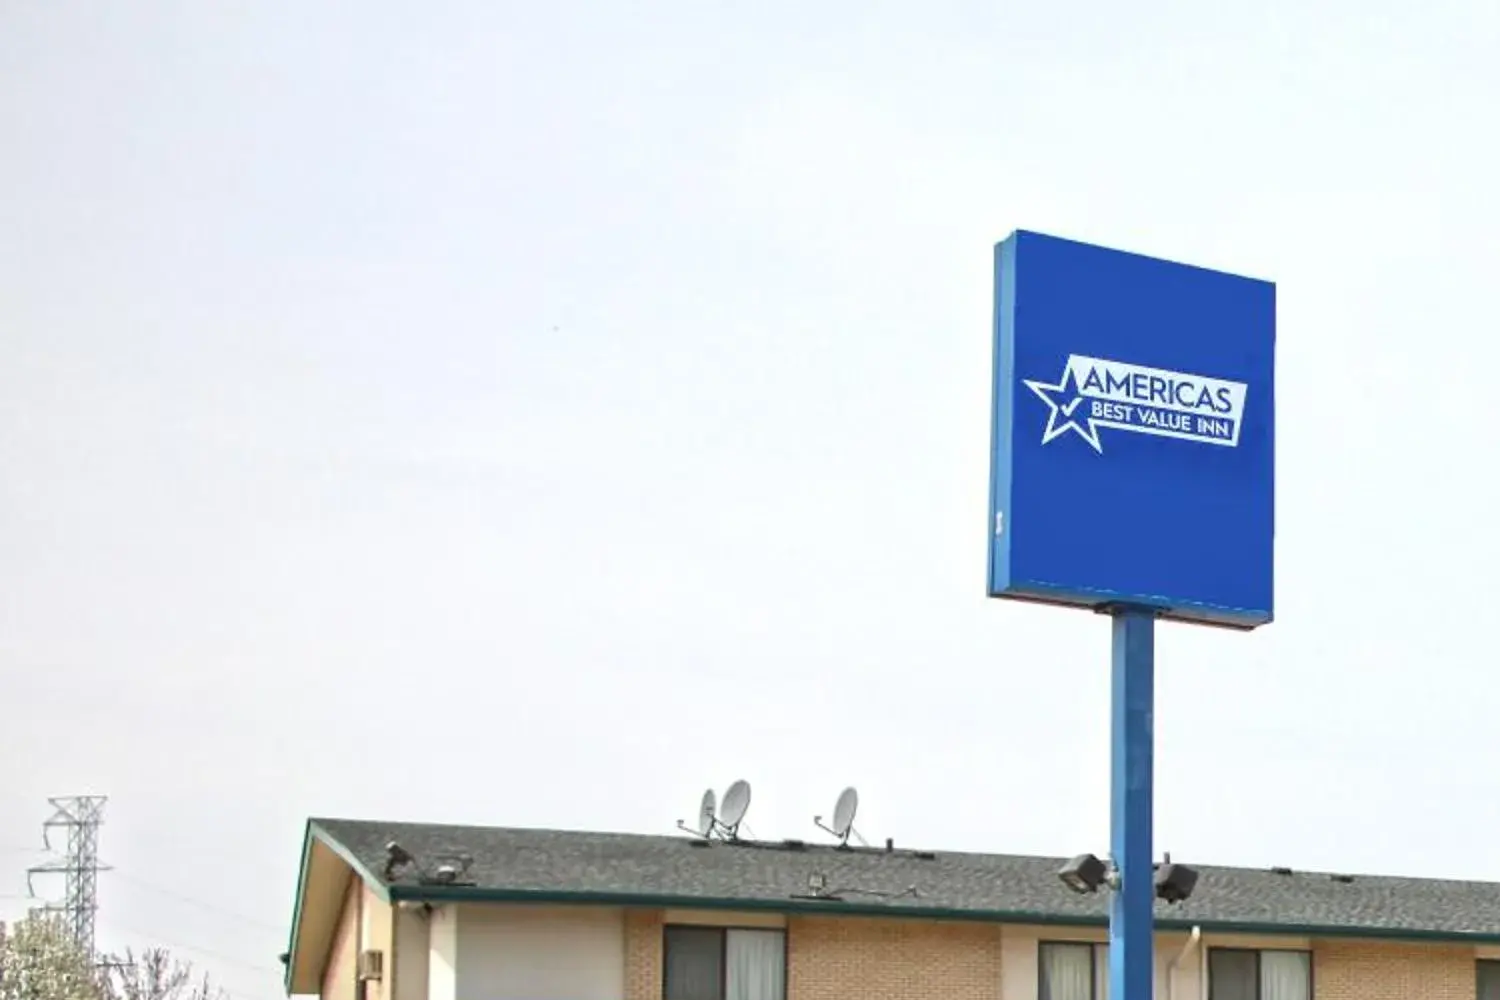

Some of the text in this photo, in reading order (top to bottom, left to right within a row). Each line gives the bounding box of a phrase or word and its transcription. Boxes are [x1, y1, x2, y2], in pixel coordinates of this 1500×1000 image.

[1082, 365, 1233, 414] AMERICAS
[1091, 400, 1230, 438] BEST VALUE INN
